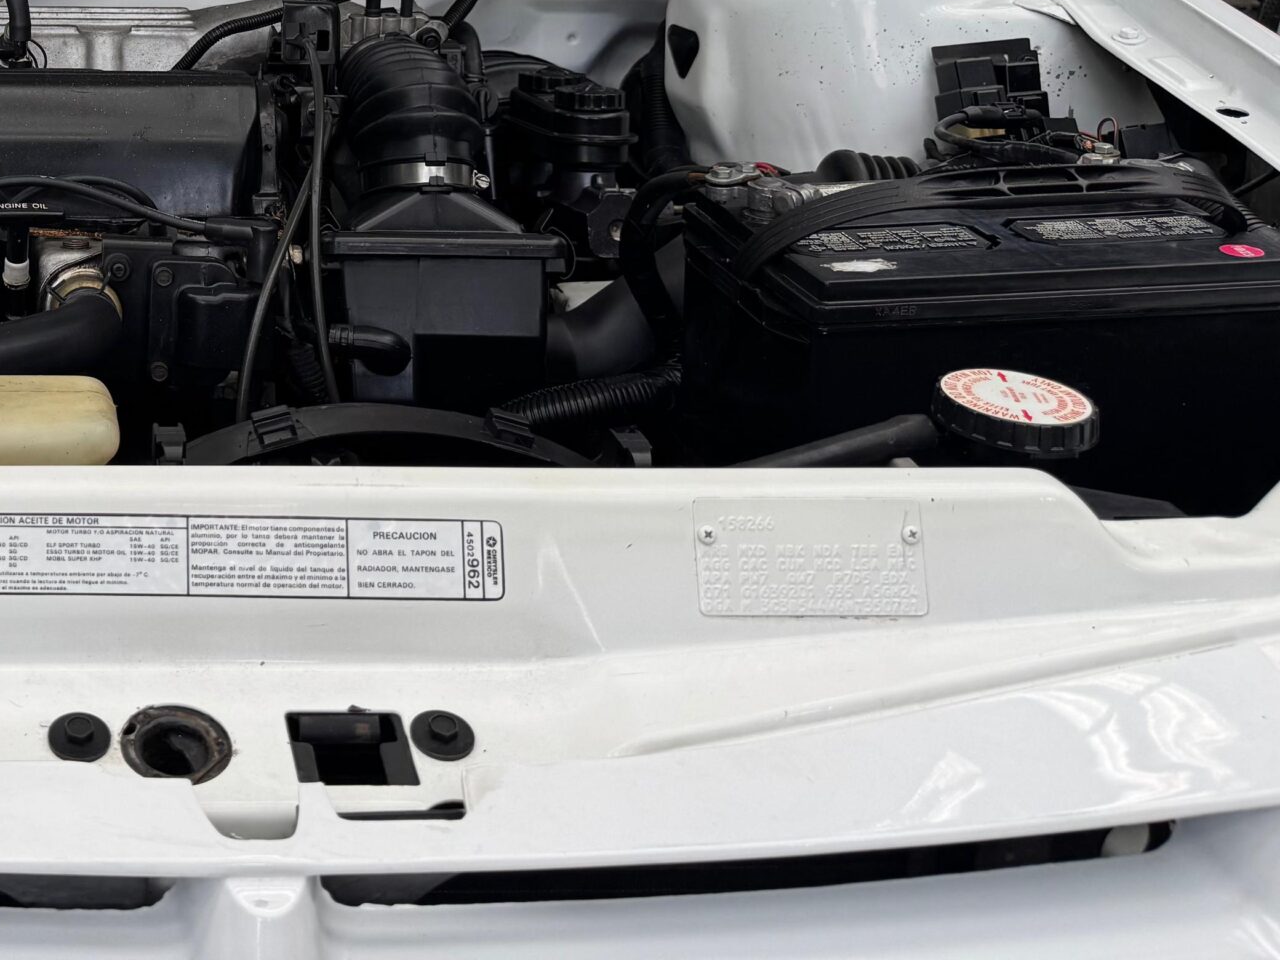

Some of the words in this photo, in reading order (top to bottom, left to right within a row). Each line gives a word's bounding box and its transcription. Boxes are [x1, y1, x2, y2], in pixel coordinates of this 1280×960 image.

[962, 399, 1020, 420] WARNING
[18, 517, 48, 525] ACEITE
[52, 517, 62, 525] DE
[66, 517, 99, 525] MOTOR
[372, 532, 436, 541] PRECAUCION
[191, 581, 234, 589] temperatura
[273, 582, 306, 590] operación
[357, 582, 374, 590] BIEN
